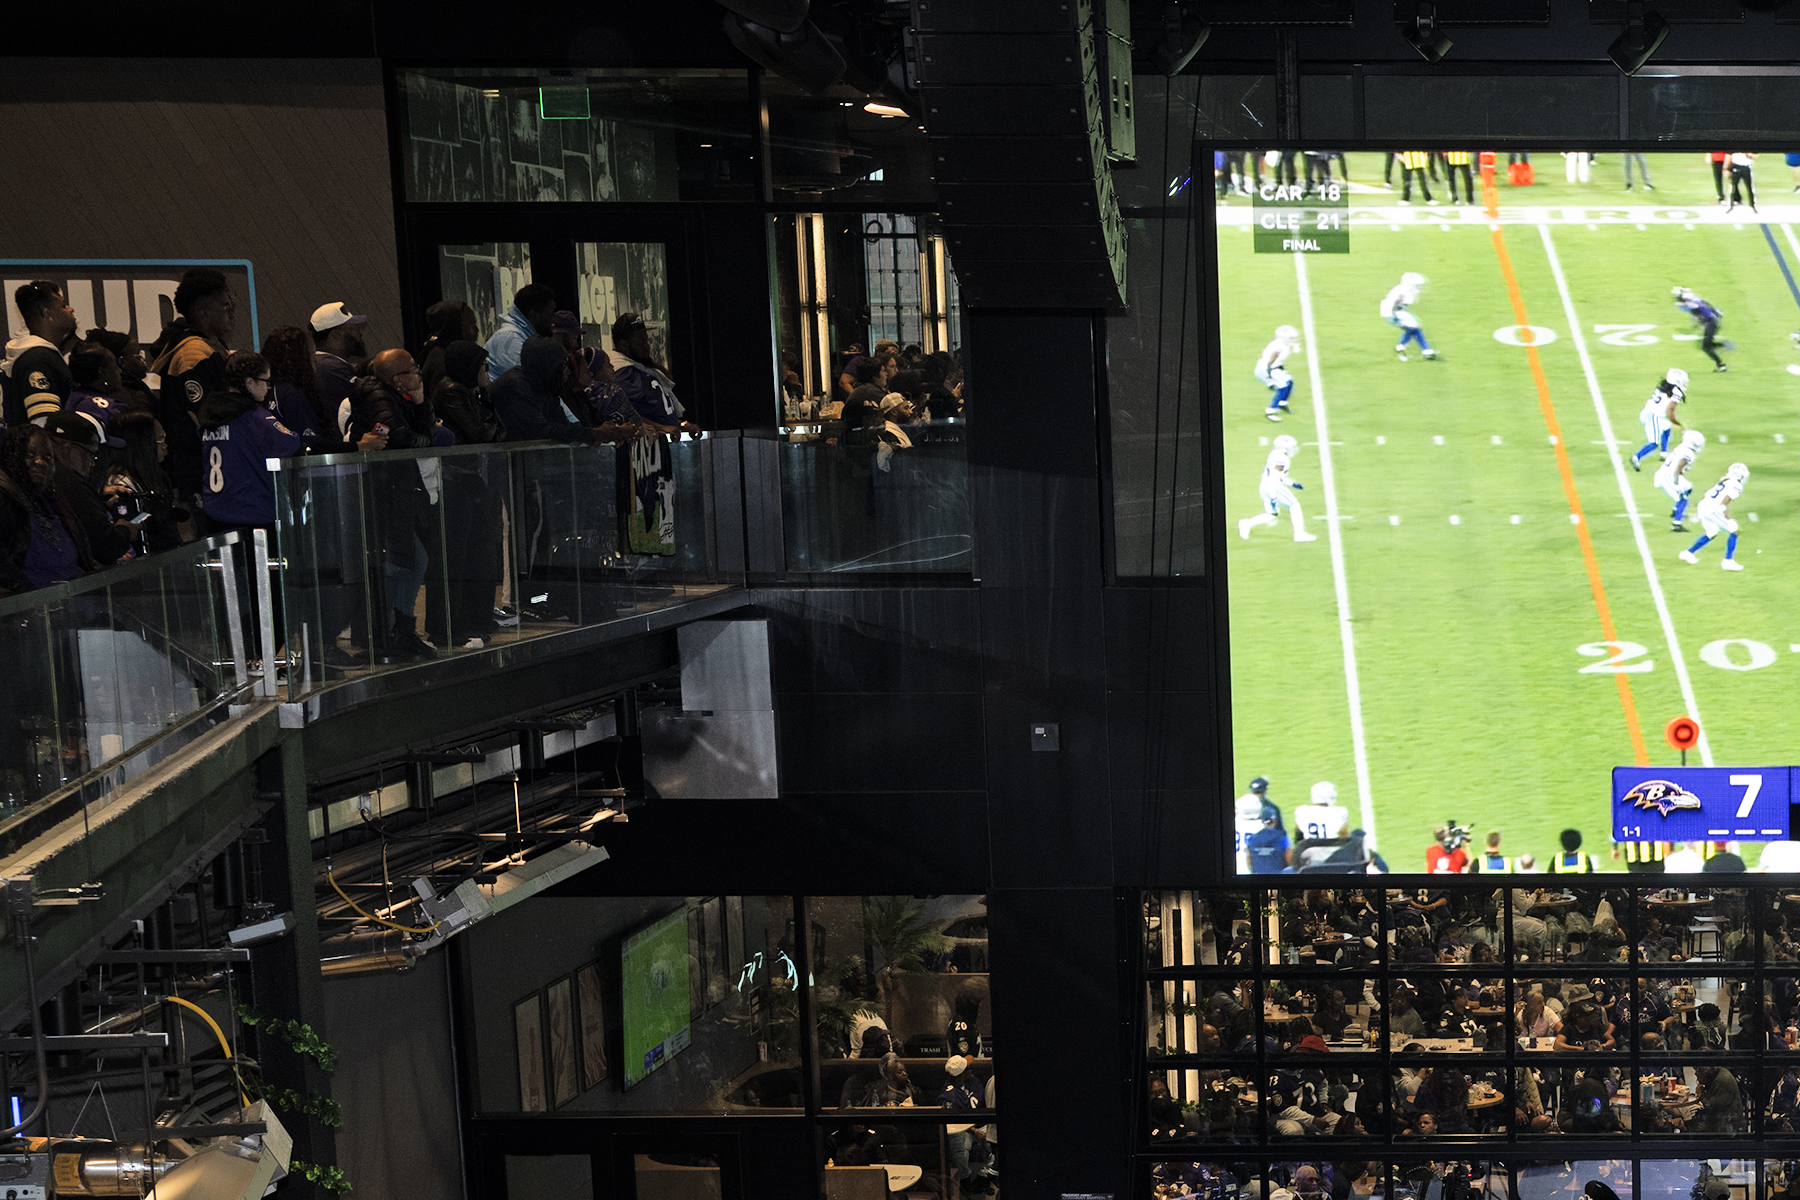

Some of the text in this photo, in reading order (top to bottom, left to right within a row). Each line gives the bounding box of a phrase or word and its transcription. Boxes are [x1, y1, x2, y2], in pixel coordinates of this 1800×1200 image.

[1260, 184, 1340, 201] CAR 18
[1260, 213, 1339, 229] CLE 21
[1283, 240, 1320, 250] FINAL
[209, 446, 224, 493] 8
[1729, 774, 1763, 818] 7
[1622, 826, 1642, 838] 1-1
[954, 1021, 968, 1031] 20
